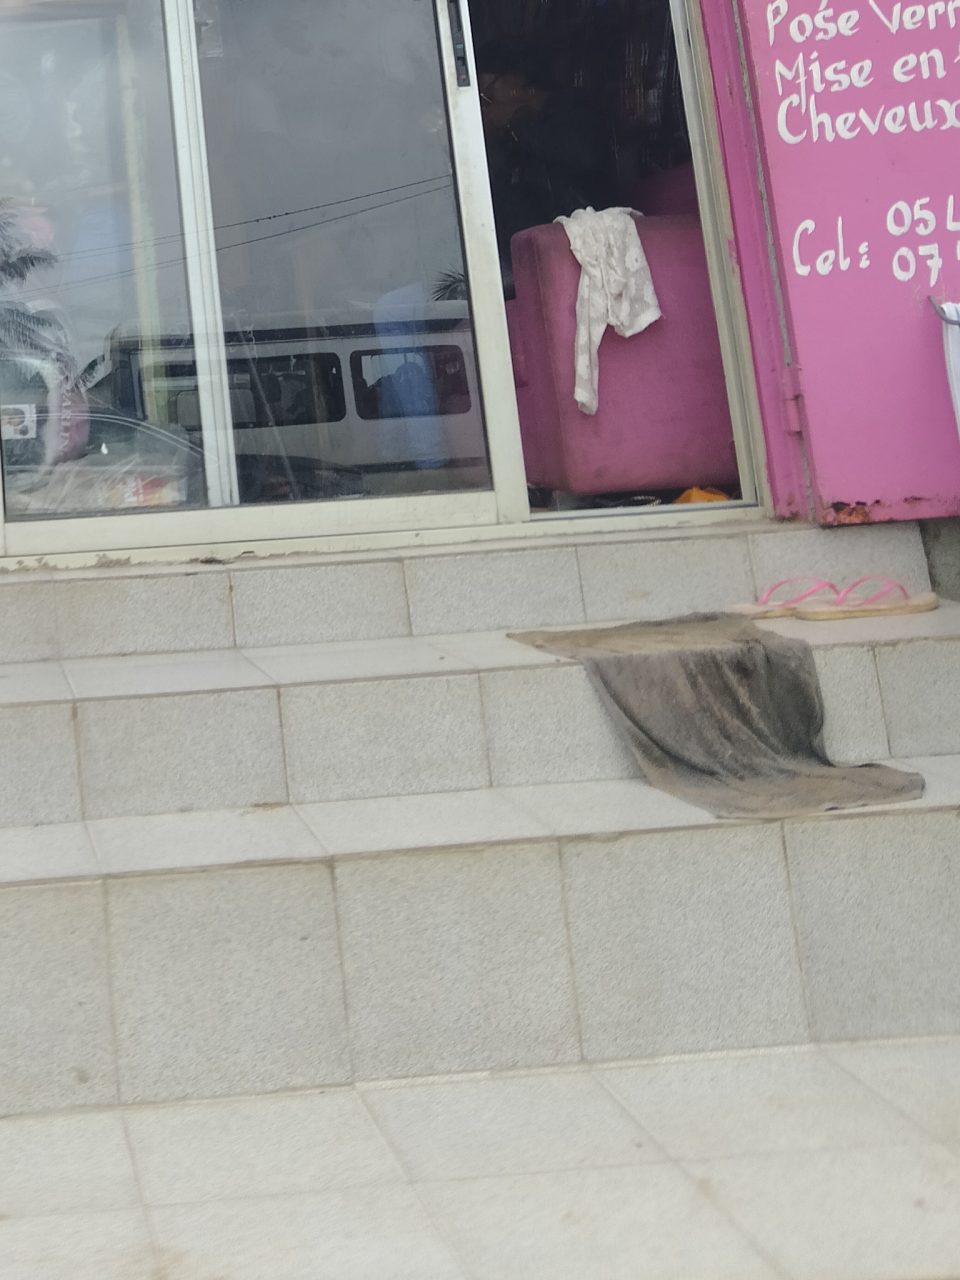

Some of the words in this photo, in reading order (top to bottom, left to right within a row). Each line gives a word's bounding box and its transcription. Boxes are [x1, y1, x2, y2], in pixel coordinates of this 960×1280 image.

[773, 49, 874, 114] Mise
[893, 48, 946, 83] en
[777, 94, 960, 145] Cheveux
[791, 215, 871, 277] Cel:
[886, 196, 937, 237] 05
[892, 243, 943, 289] 07
